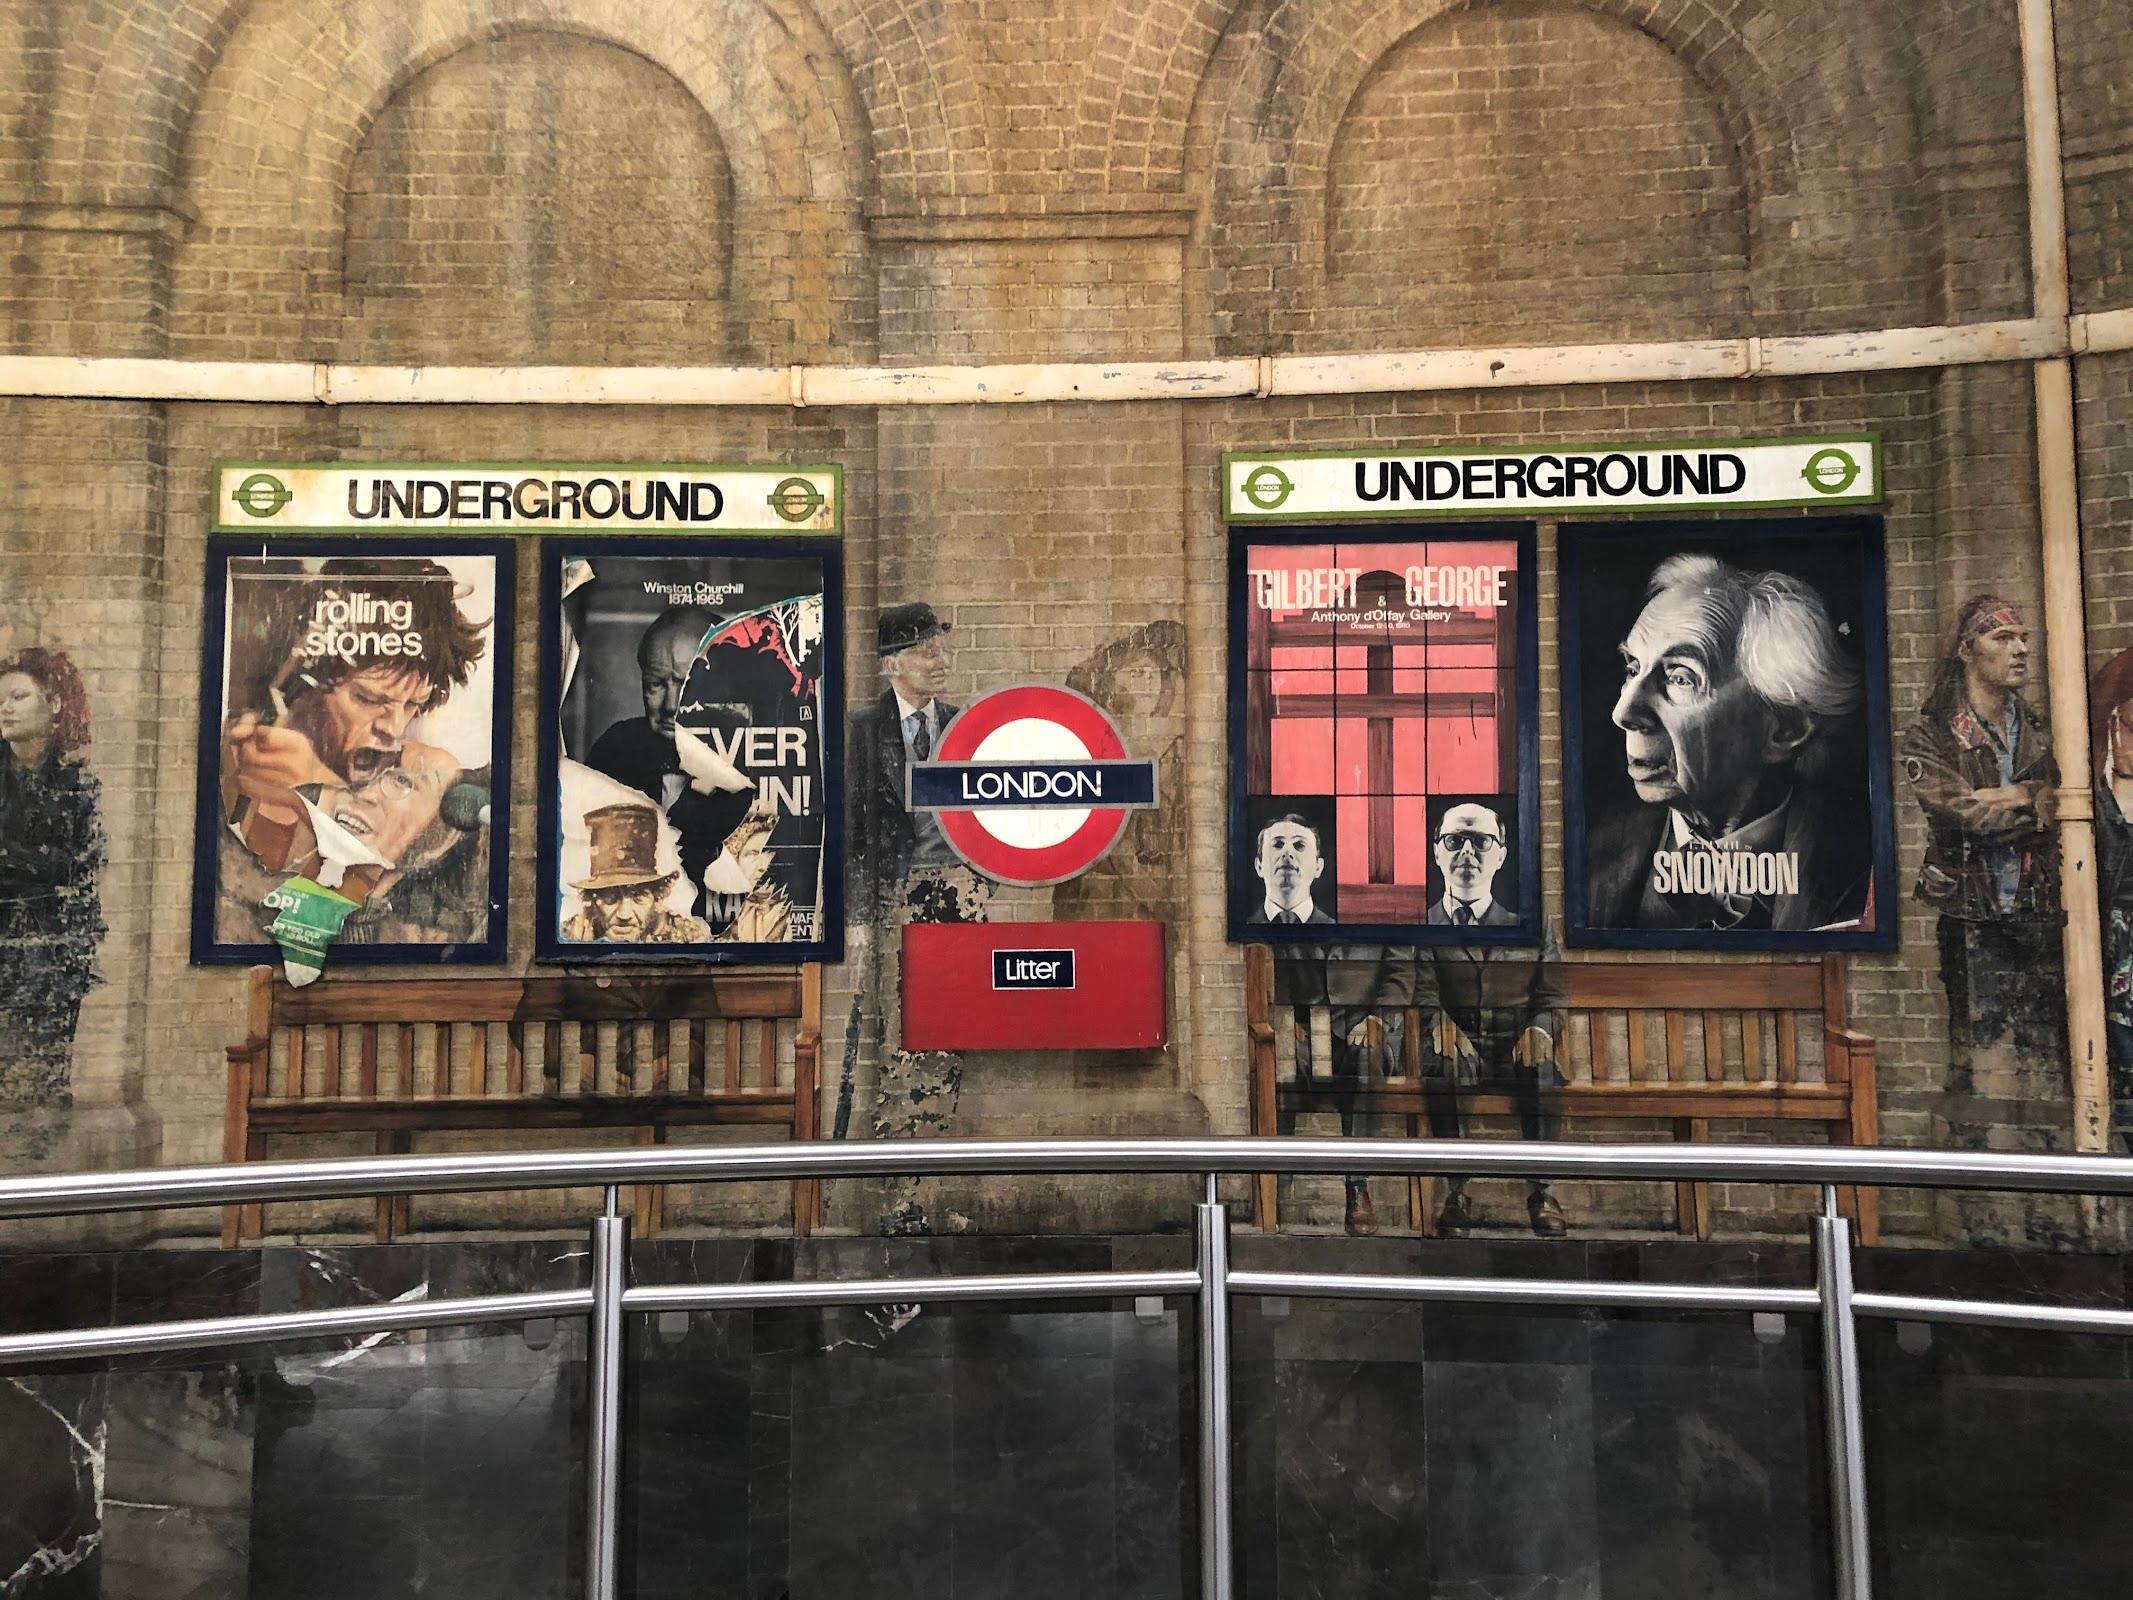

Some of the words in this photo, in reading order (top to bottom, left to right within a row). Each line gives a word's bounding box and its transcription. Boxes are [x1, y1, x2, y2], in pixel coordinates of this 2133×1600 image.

[1356, 454, 1746, 501] UNDERGROUND
[349, 478, 724, 521] UNDERGROUND
[643, 582, 691, 593] Winston
[695, 582, 744, 594] Churchill
[1256, 569, 1362, 609] GILBERT
[1378, 595, 1387, 607] &
[1405, 566, 1507, 606] GEORGE
[315, 593, 412, 630] rolling
[1311, 611, 1361, 624] Anthony
[1410, 609, 1451, 623] Gallery
[305, 625, 423, 656] stones
[962, 770, 1102, 799] LONDON
[1653, 851, 1799, 895] SNOWDON
[1006, 959, 1060, 980] Litter
